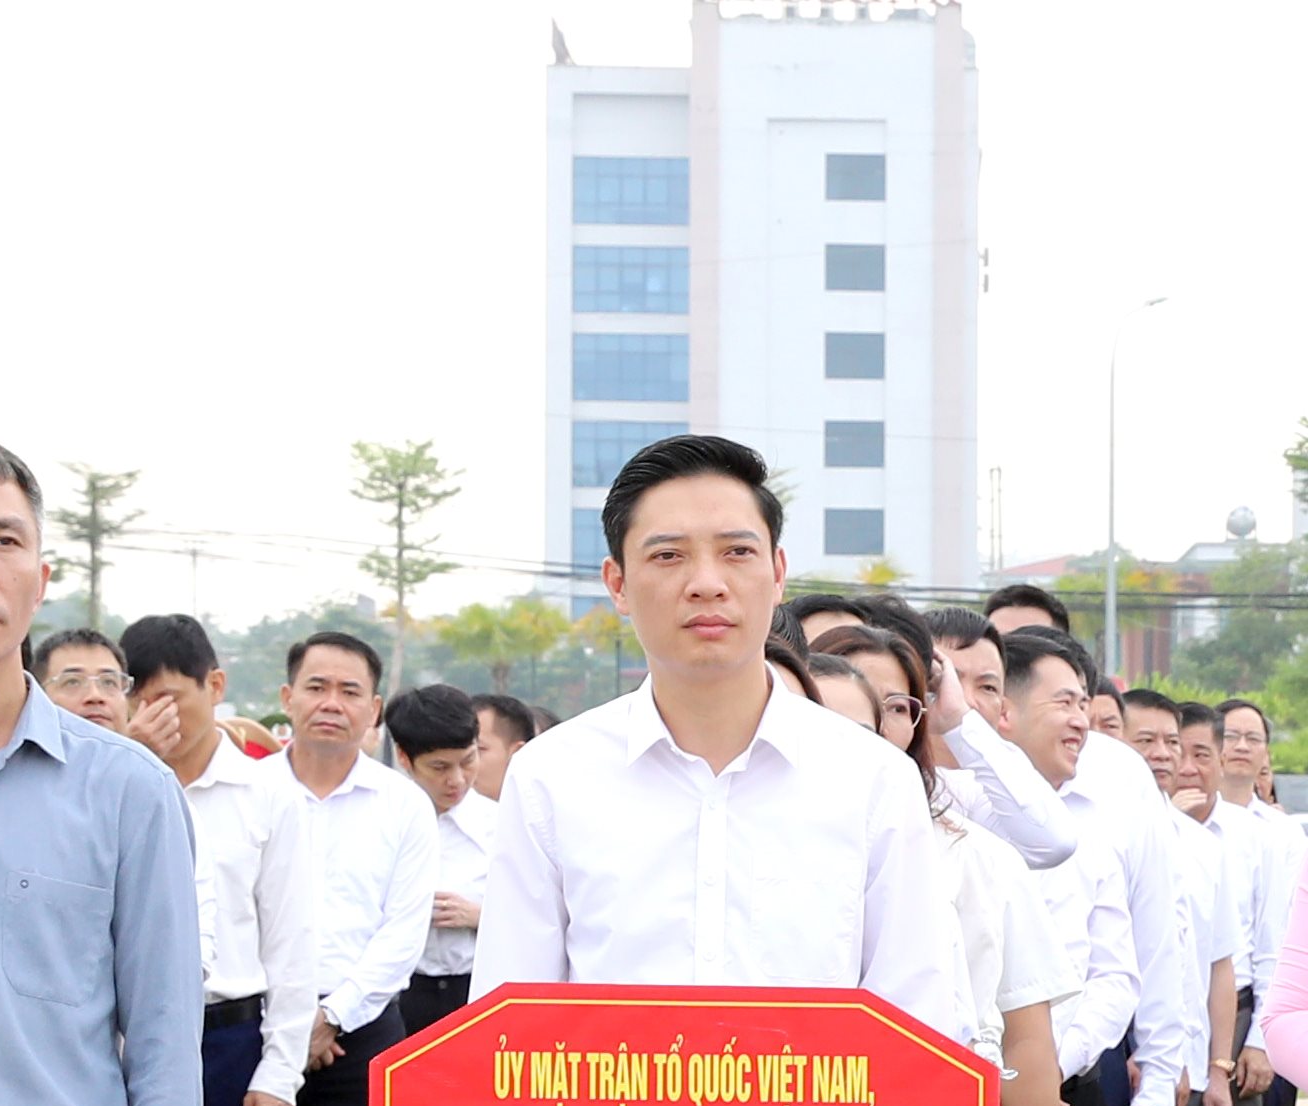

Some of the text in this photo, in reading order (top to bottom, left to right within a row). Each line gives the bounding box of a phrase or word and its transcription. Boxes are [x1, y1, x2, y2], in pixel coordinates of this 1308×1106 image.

[494, 1035, 525, 1100] ỦY
[654, 1034, 684, 1102] TỔ
[688, 1037, 752, 1106] QUỐC
